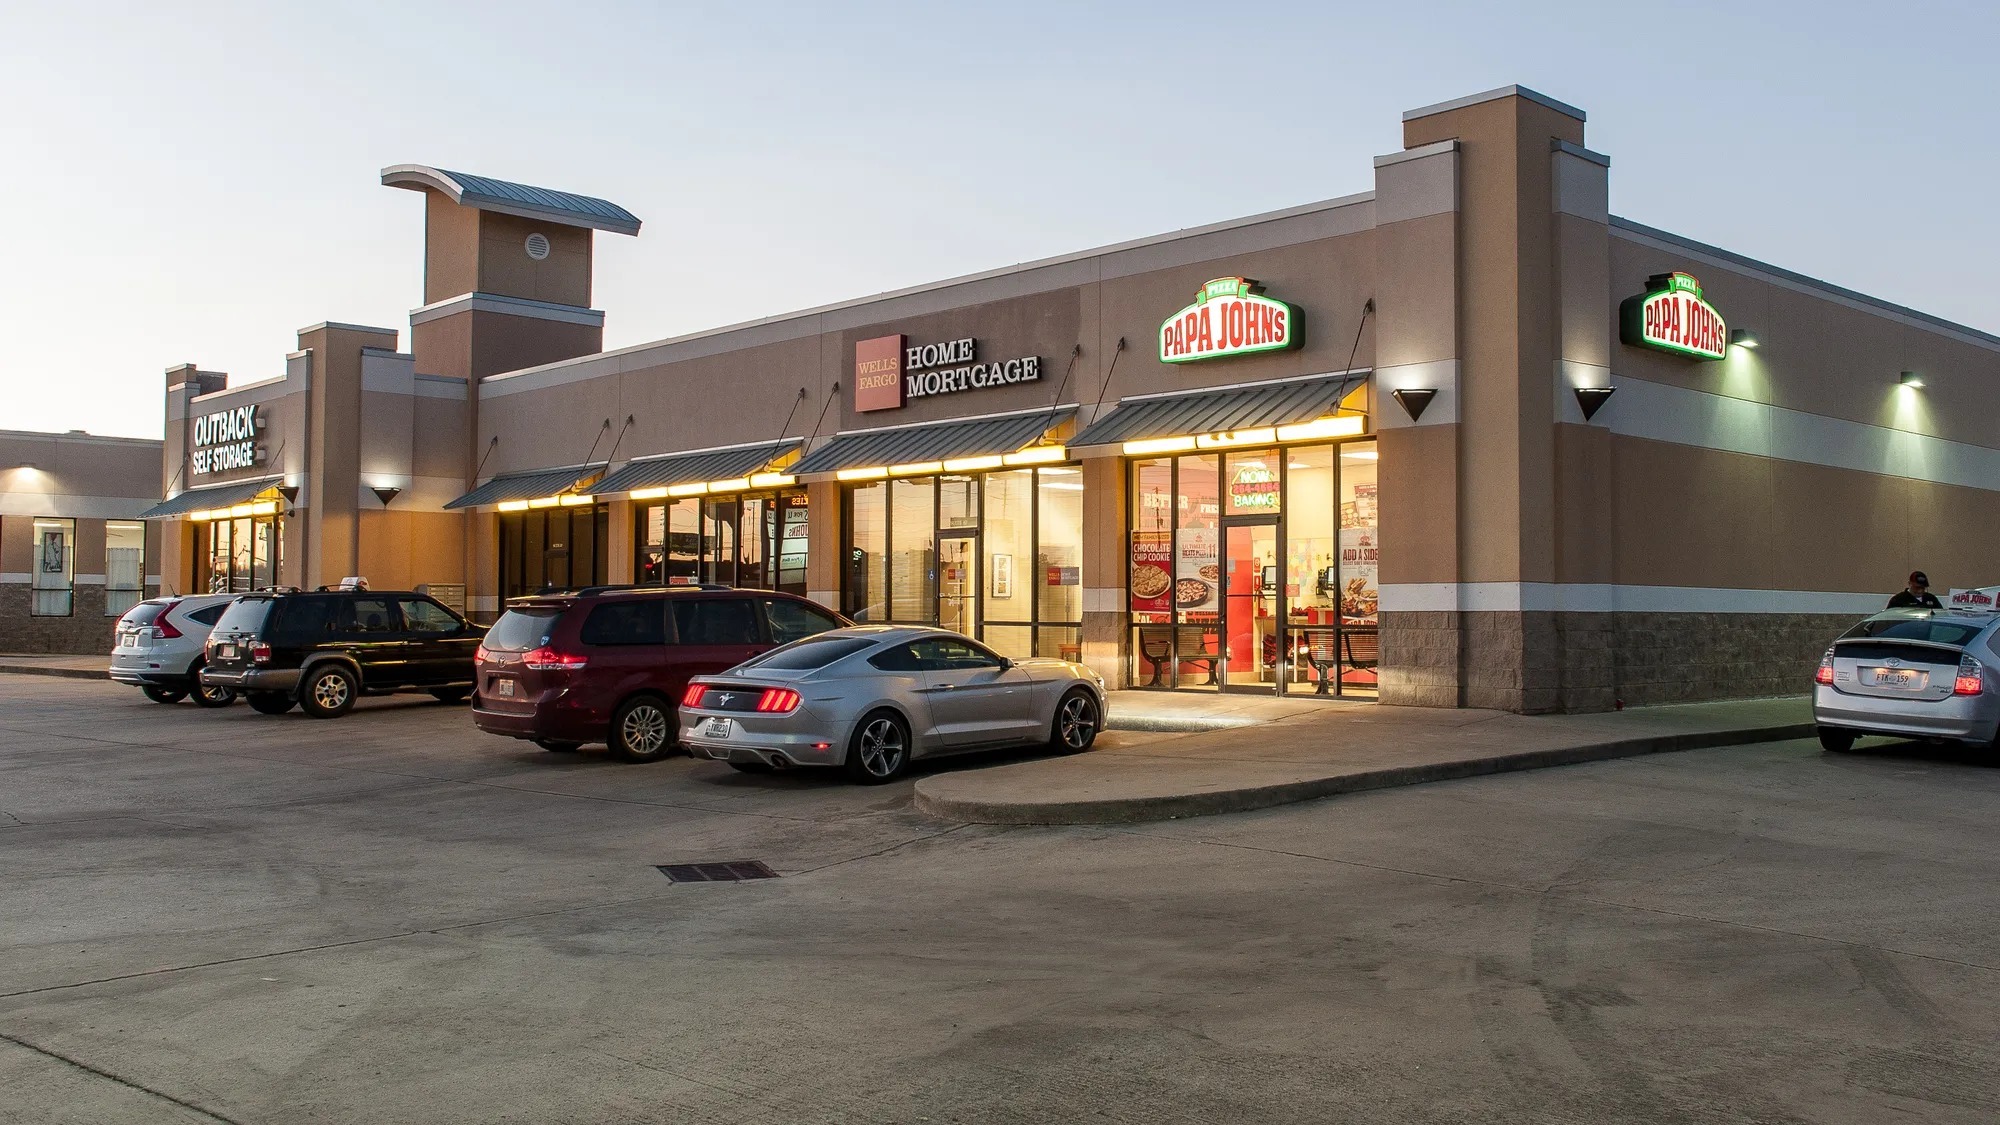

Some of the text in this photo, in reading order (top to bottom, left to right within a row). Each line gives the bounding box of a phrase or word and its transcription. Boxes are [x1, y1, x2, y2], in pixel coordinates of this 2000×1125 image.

[1208, 280, 1237, 295] PIZZA
[1676, 276, 1695, 289] PIZZA
[1646, 297, 1680, 343] PAPA
[1164, 301, 1286, 356] PAPA JOHN'S
[906, 337, 976, 370] HOME
[858, 358, 898, 374] WELLS
[859, 374, 898, 390] FARGO
[906, 356, 1041, 398] MORTGAGE
[194, 404, 256, 447] OUTBACK
[193, 441, 253, 475] SELF STORAGE
[1240, 470, 1270, 483] NOW
[1234, 493, 1275, 507] BAKING
[1133, 543, 1171, 552] CHOCOLATE
[1343, 548, 1378, 561] ADD A SIDE
[1133, 552, 1171, 561] CHIP COOKIE
[1897, 674, 1909, 683] 159
